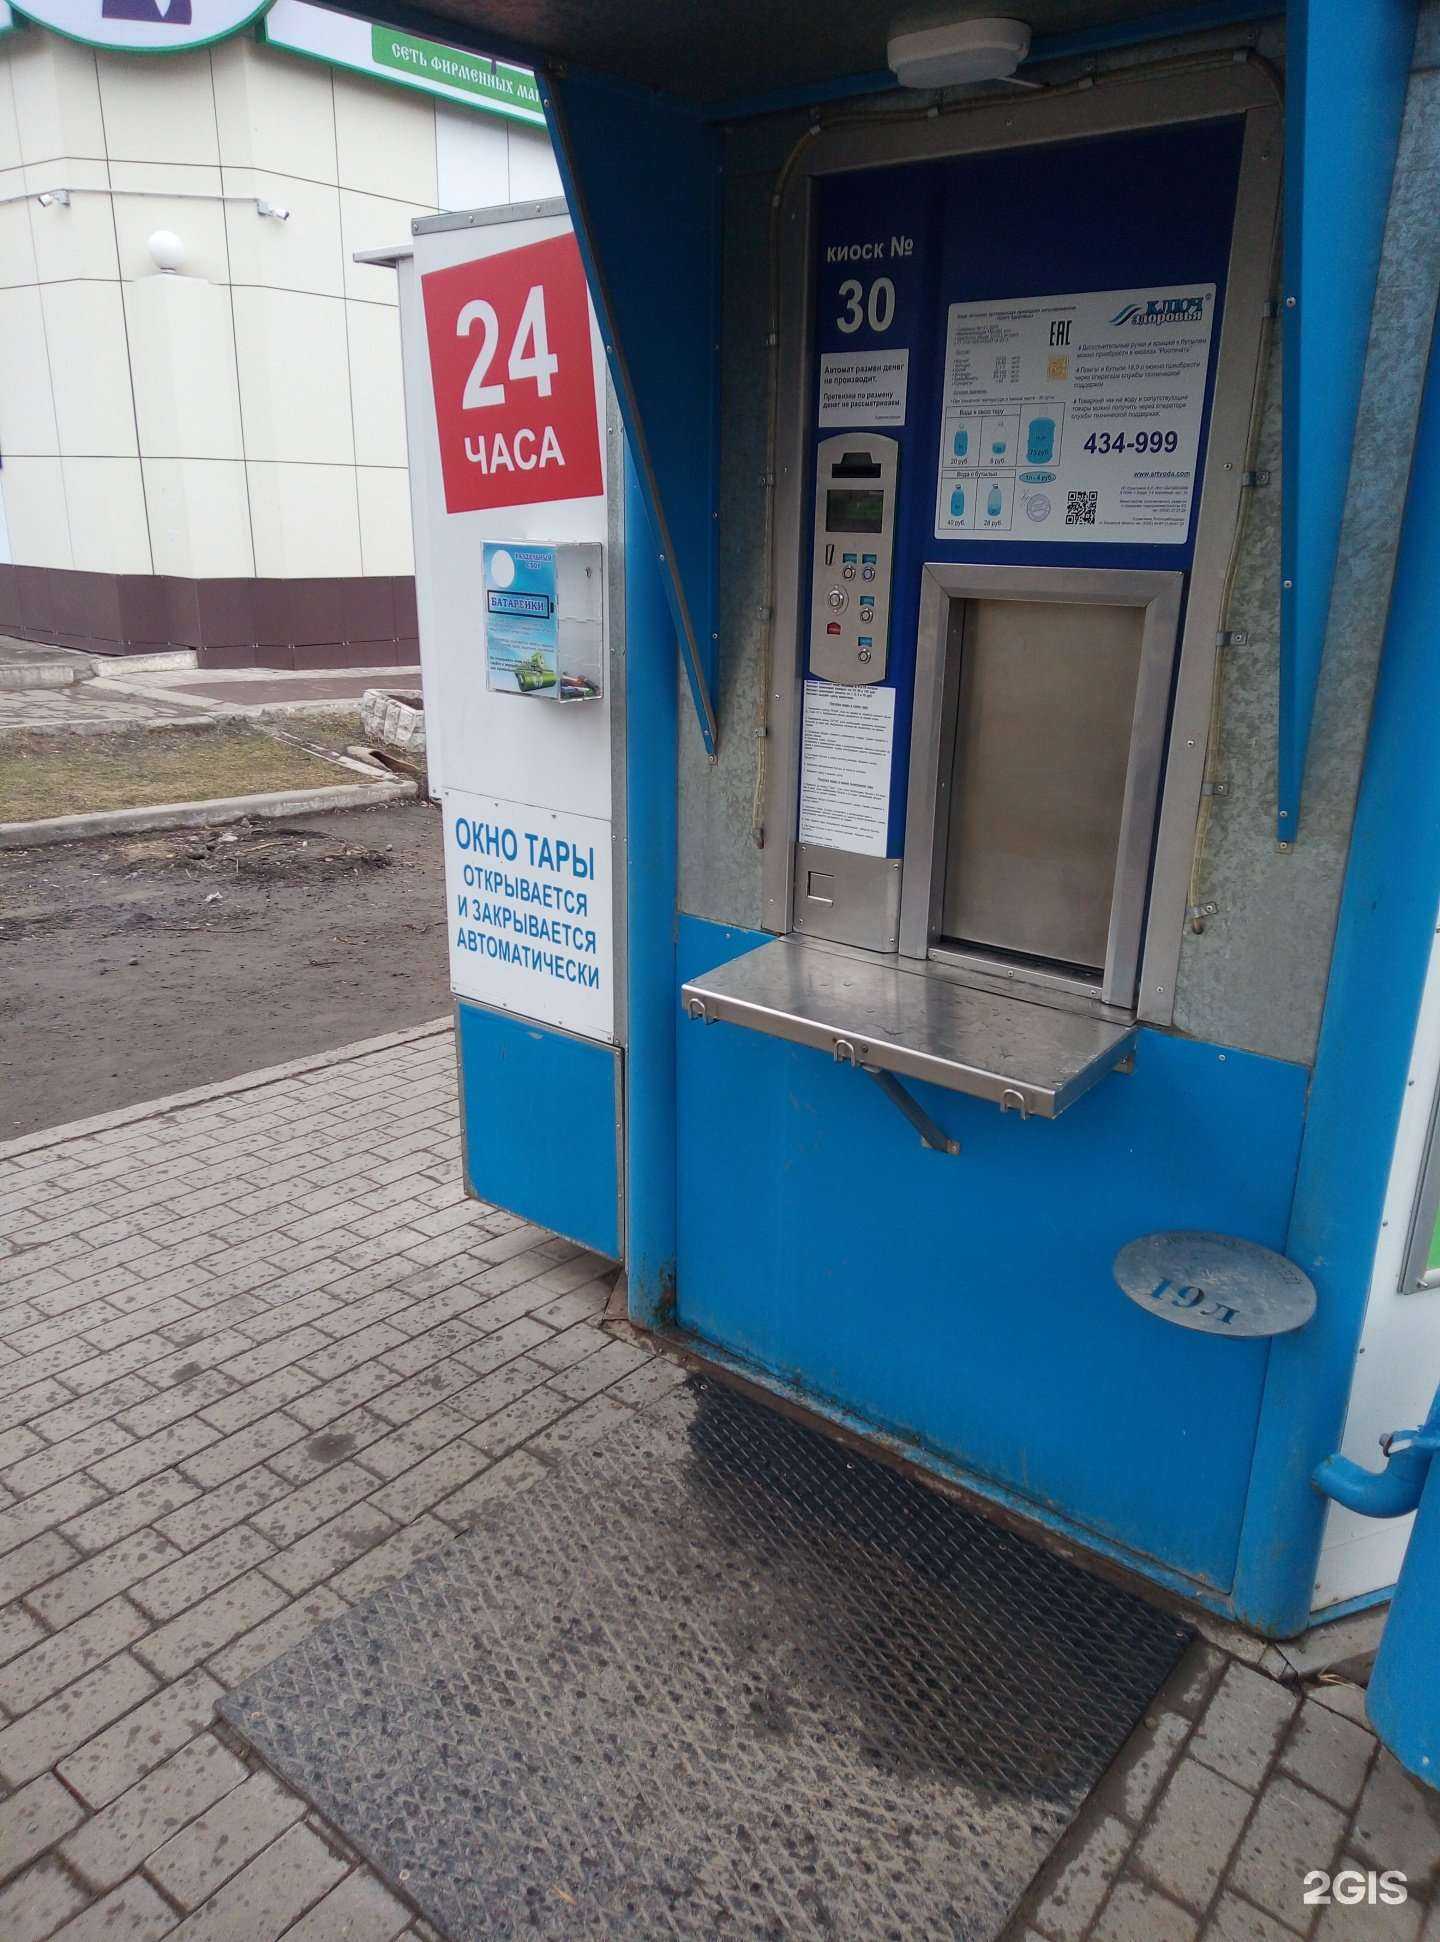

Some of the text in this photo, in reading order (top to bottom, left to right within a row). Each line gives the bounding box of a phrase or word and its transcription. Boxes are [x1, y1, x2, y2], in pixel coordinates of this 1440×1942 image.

[391, 42, 427, 67] СЕТЬ
[430, 56, 513, 94] ФИРМЕННЫХ
[837, 277, 896, 334] 30
[456, 285, 559, 410] 24
[824, 366, 854, 374] Автомат
[855, 366, 881, 374] размен
[464, 426, 566, 474] ЧАСА
[1083, 431, 1178, 455] 434-999
[456, 817, 594, 881] ОКНО ТАРЫ
[464, 864, 588, 918] ОТКРЫВАЕТСЯ
[458, 895, 596, 955] И ЗАКРЫВАЕТСЯ
[457, 927, 600, 990] АВТОМАТИЧЕСКИ
